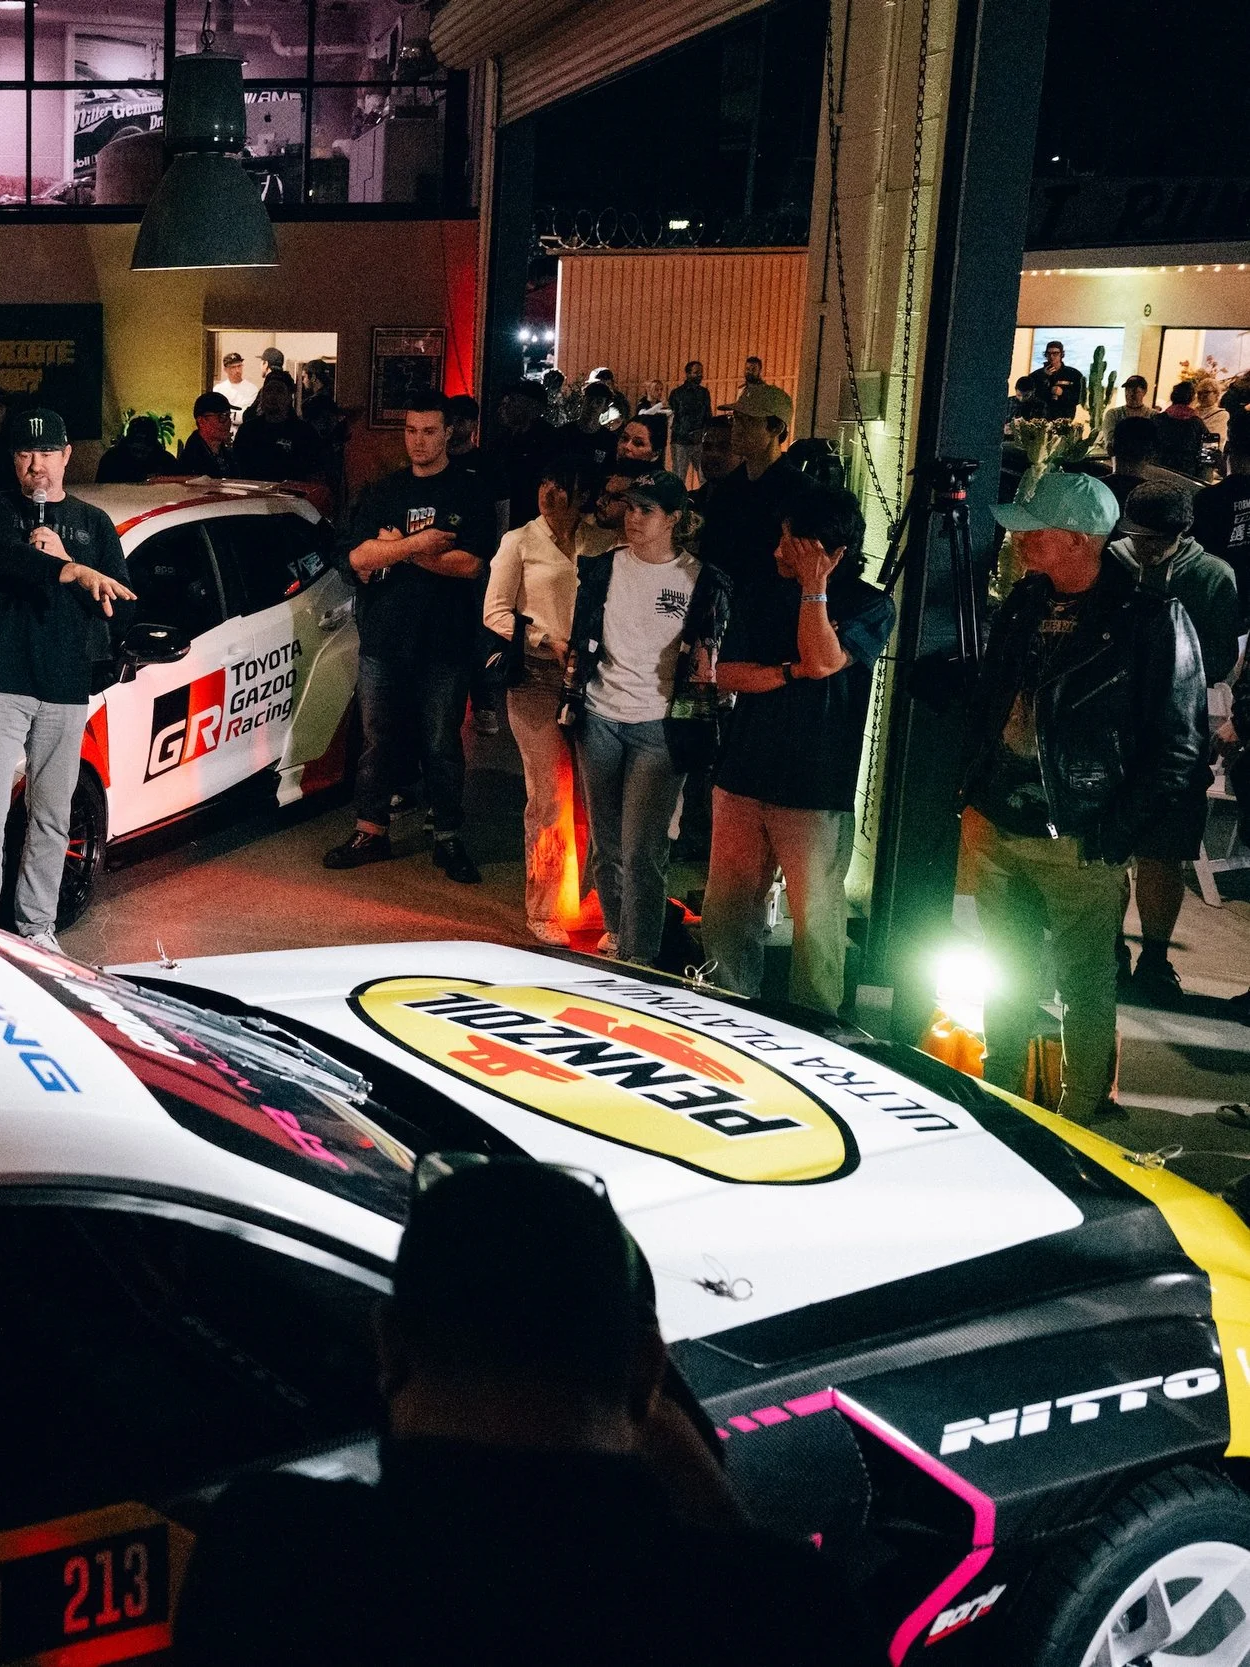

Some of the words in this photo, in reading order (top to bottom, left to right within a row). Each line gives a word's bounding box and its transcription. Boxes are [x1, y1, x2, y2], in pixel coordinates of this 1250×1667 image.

[229, 668, 297, 715] GAZOO
[231, 639, 303, 686] TOYOTA
[148, 704, 222, 776] GR
[225, 697, 293, 742] Racing
[576, 978, 803, 1052] PLATINUM
[406, 992, 805, 1137] PENNZOIL
[793, 1055, 959, 1132] ULTRA
[939, 1367, 1221, 1456] NITTO
[62, 1542, 149, 1634] 213
